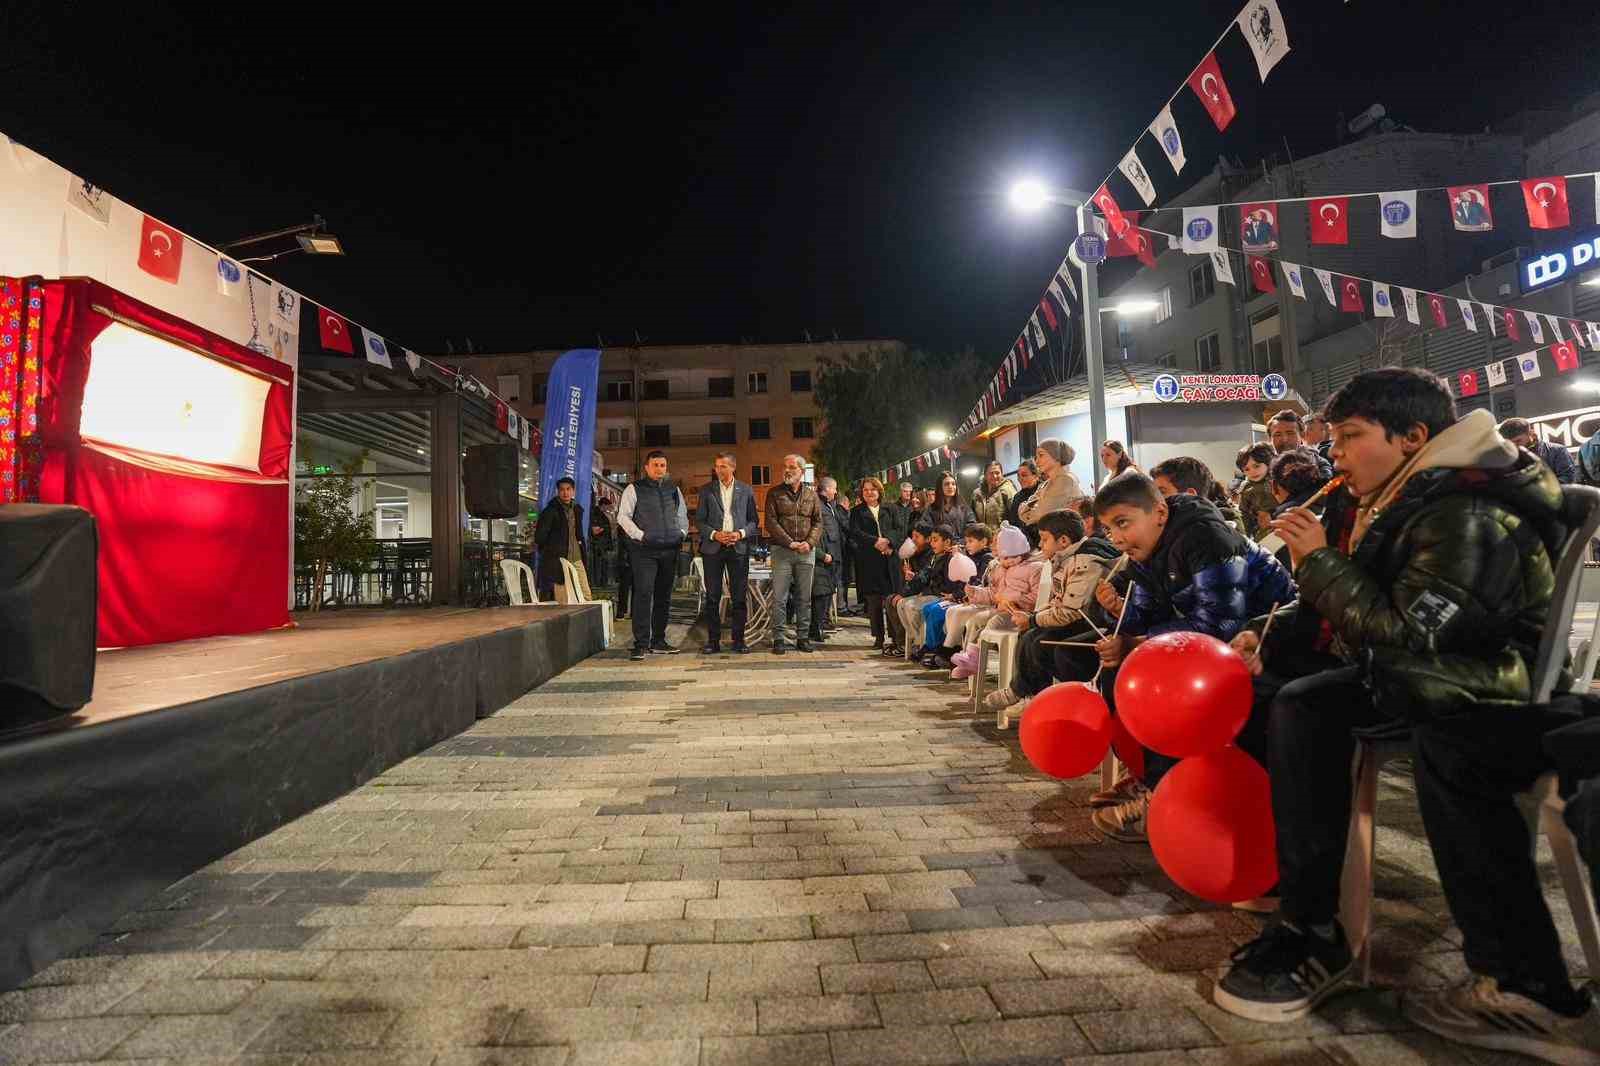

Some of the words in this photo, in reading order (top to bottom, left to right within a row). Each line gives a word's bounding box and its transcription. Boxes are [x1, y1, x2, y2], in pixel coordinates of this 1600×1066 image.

[1181, 375, 1206, 385] KENT
[1209, 375, 1260, 385] LOKANTASI
[1182, 388, 1212, 403] ÇAY
[1214, 384, 1260, 401] OCAĞI
[567, 385, 582, 457] BELEDİYESİ
[554, 426, 565, 449] T.C.
